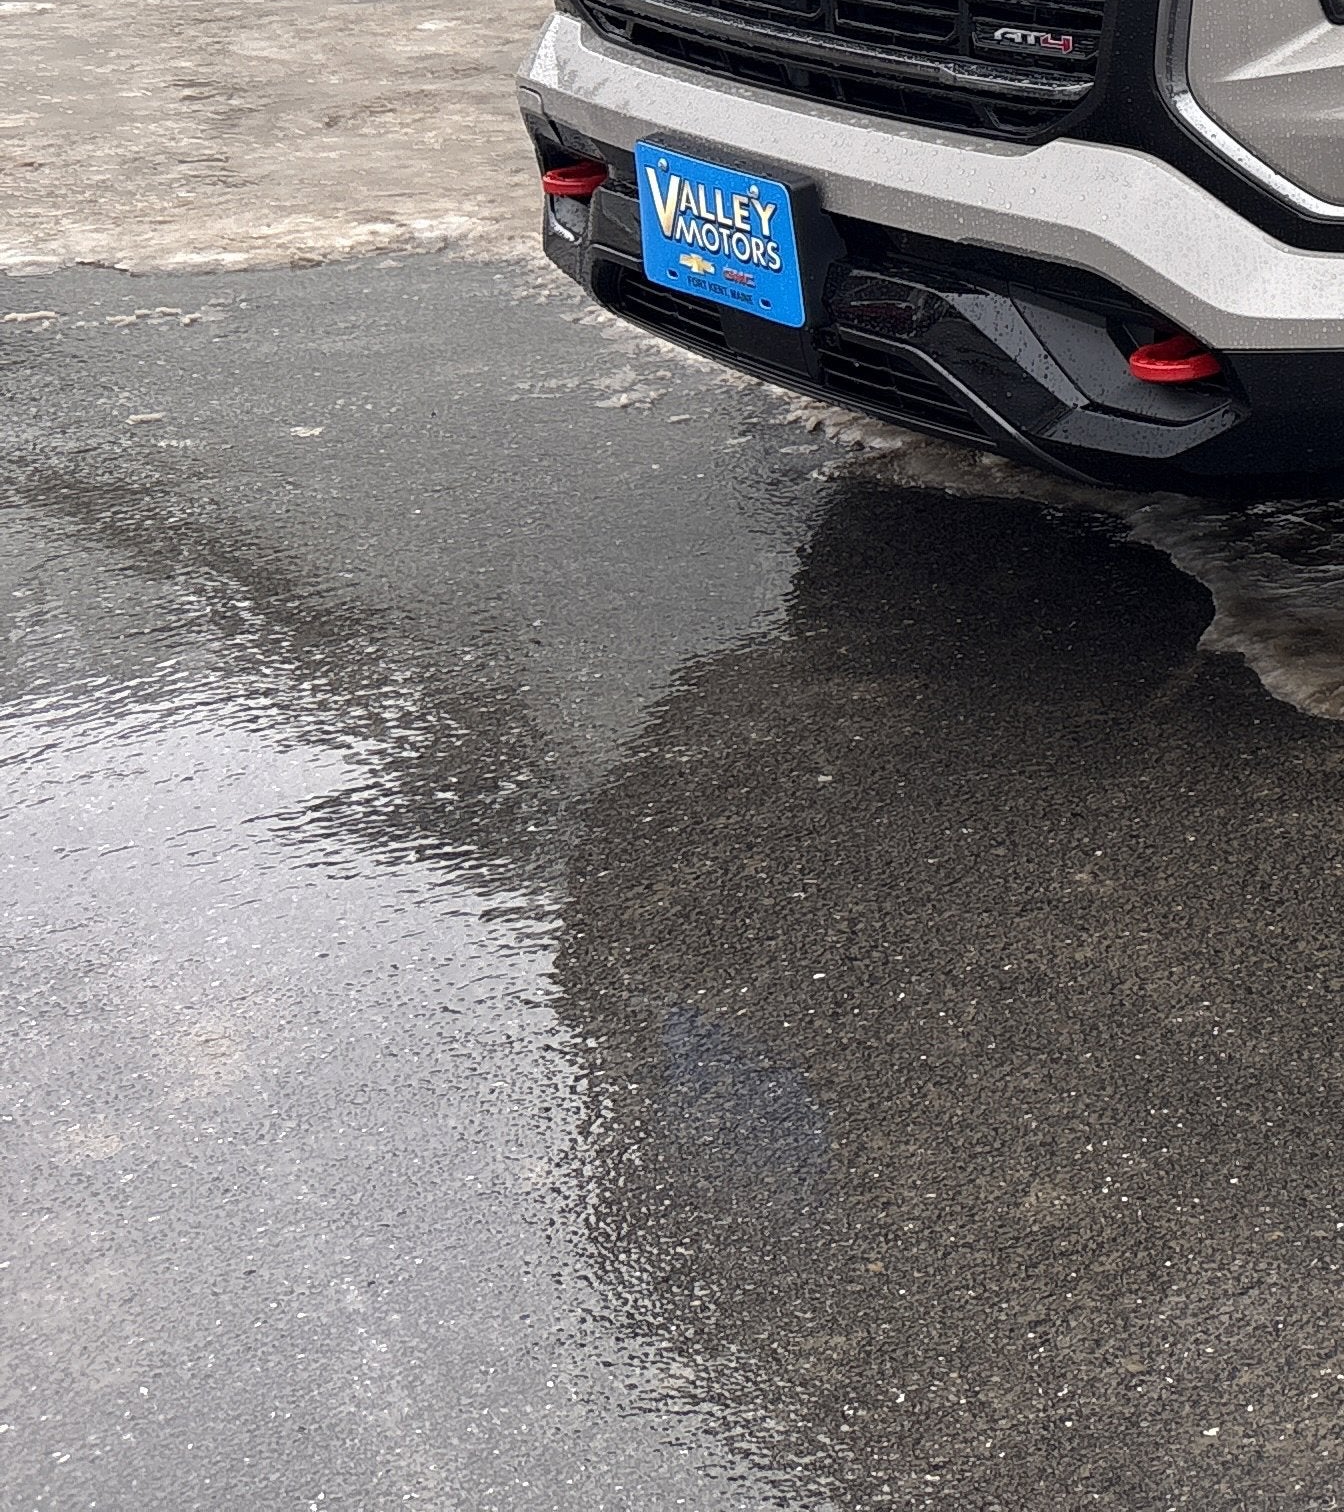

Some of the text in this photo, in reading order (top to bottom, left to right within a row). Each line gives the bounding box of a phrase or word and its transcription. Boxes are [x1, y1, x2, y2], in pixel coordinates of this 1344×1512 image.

[994, 28, 1072, 54] AT4
[645, 166, 776, 238] VALLEY
[675, 215, 782, 271] MOTORS
